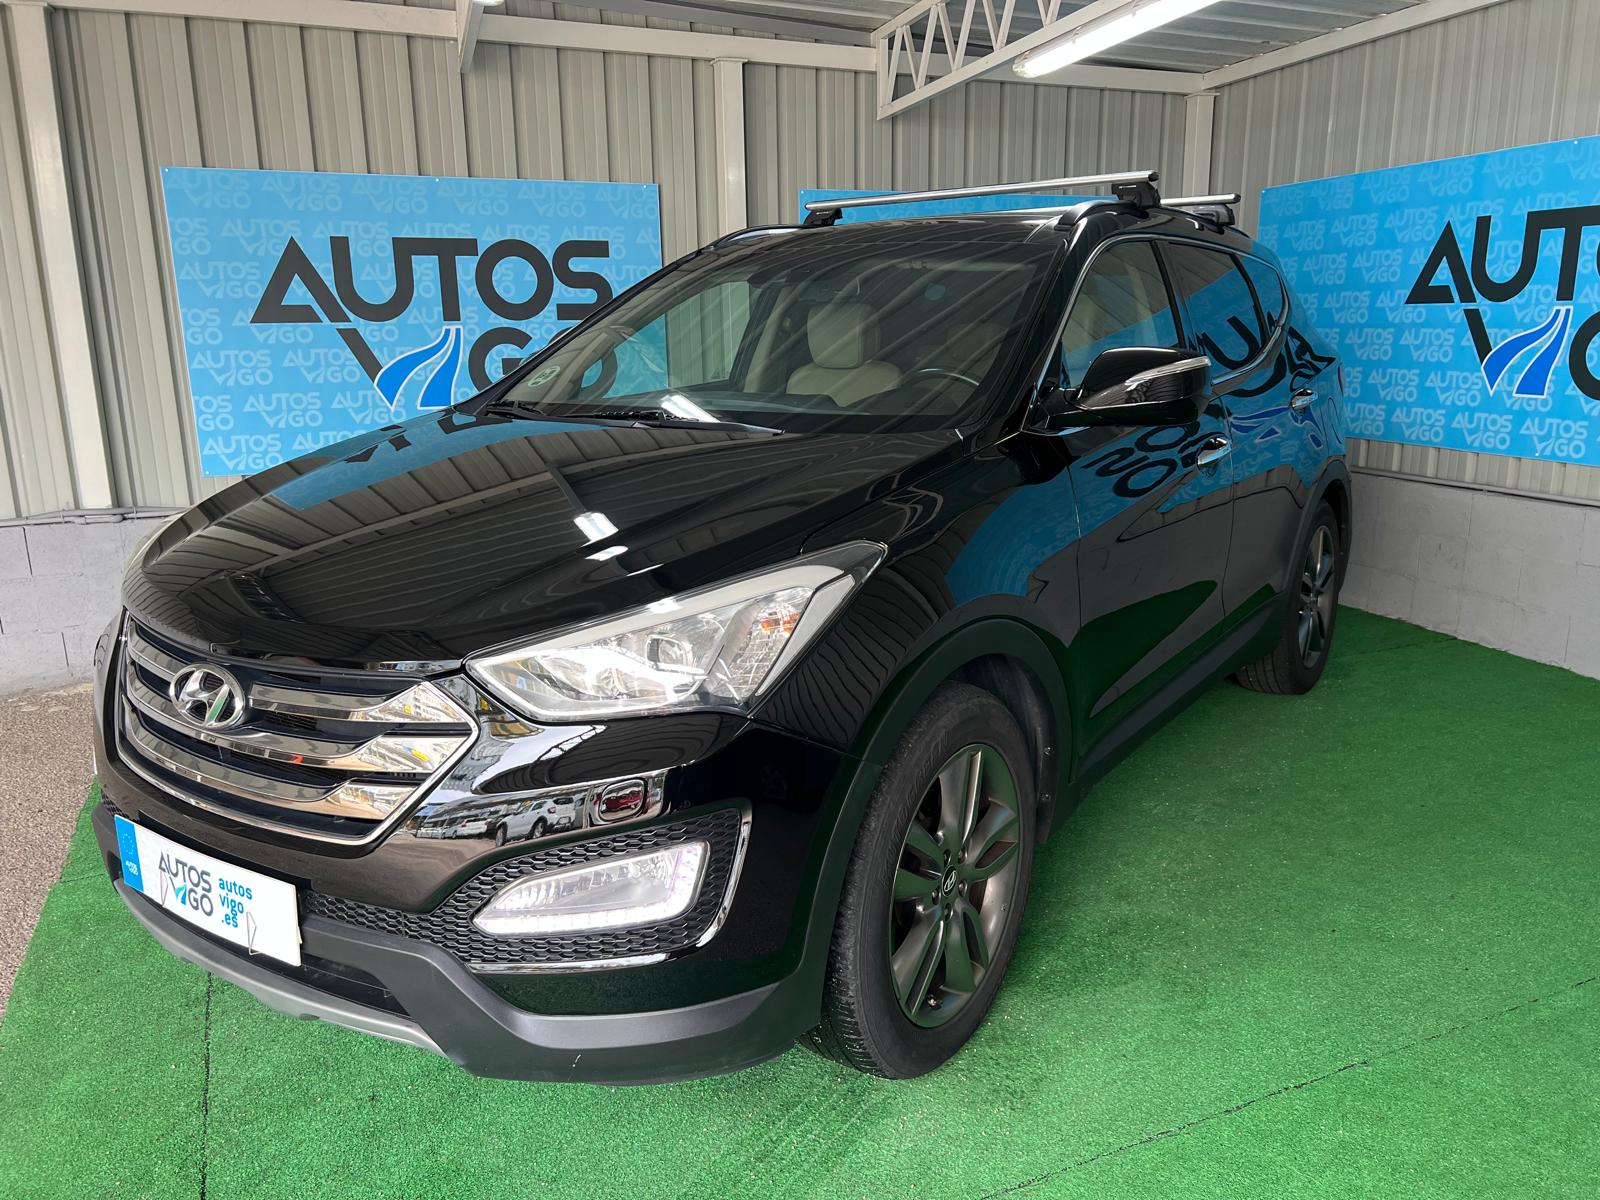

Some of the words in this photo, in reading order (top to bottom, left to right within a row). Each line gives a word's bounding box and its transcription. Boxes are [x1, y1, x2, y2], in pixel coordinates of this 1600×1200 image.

[1384, 206, 1438, 228] AUTOS
[1352, 249, 1403, 268] AUTOS
[250, 235, 613, 323] AUTOS
[1323, 291, 1370, 309] AUTOS
[1385, 307, 1426, 324] VIGO
[250, 327, 314, 345] VIGO
[1344, 327, 1394, 345] AUTOS
[1399, 327, 1456, 346] AUTOS
[191, 350, 271, 369] AUTOS
[1354, 344, 1392, 360] VIGO
[1410, 345, 1453, 362] VIGO
[208, 368, 274, 387] VIGO
[300, 366, 360, 384] VIGO
[1368, 367, 1419, 386] AUTOS
[1424, 370, 1482, 389] AUTOS
[243, 391, 322, 413] AUTOS
[1377, 384, 1417, 402] VIGO
[1435, 387, 1481, 407] VIGO
[259, 410, 323, 429] VIGO
[1391, 407, 1446, 427] AUTOS
[1452, 411, 1513, 432] AUTOS
[1401, 423, 1444, 442] VIGO
[1519, 416, 1590, 440] AUTOS
[203, 434, 282, 455] AUTOS
[1463, 431, 1511, 450] VIGO
[1533, 437, 1586, 459] VIGO
[218, 452, 283, 471] VIGO
[158, 850, 213, 894] AUTOS
[218, 876, 253, 900] autos
[219, 893, 244, 917] vigo
[221, 911, 239, 928] .es
